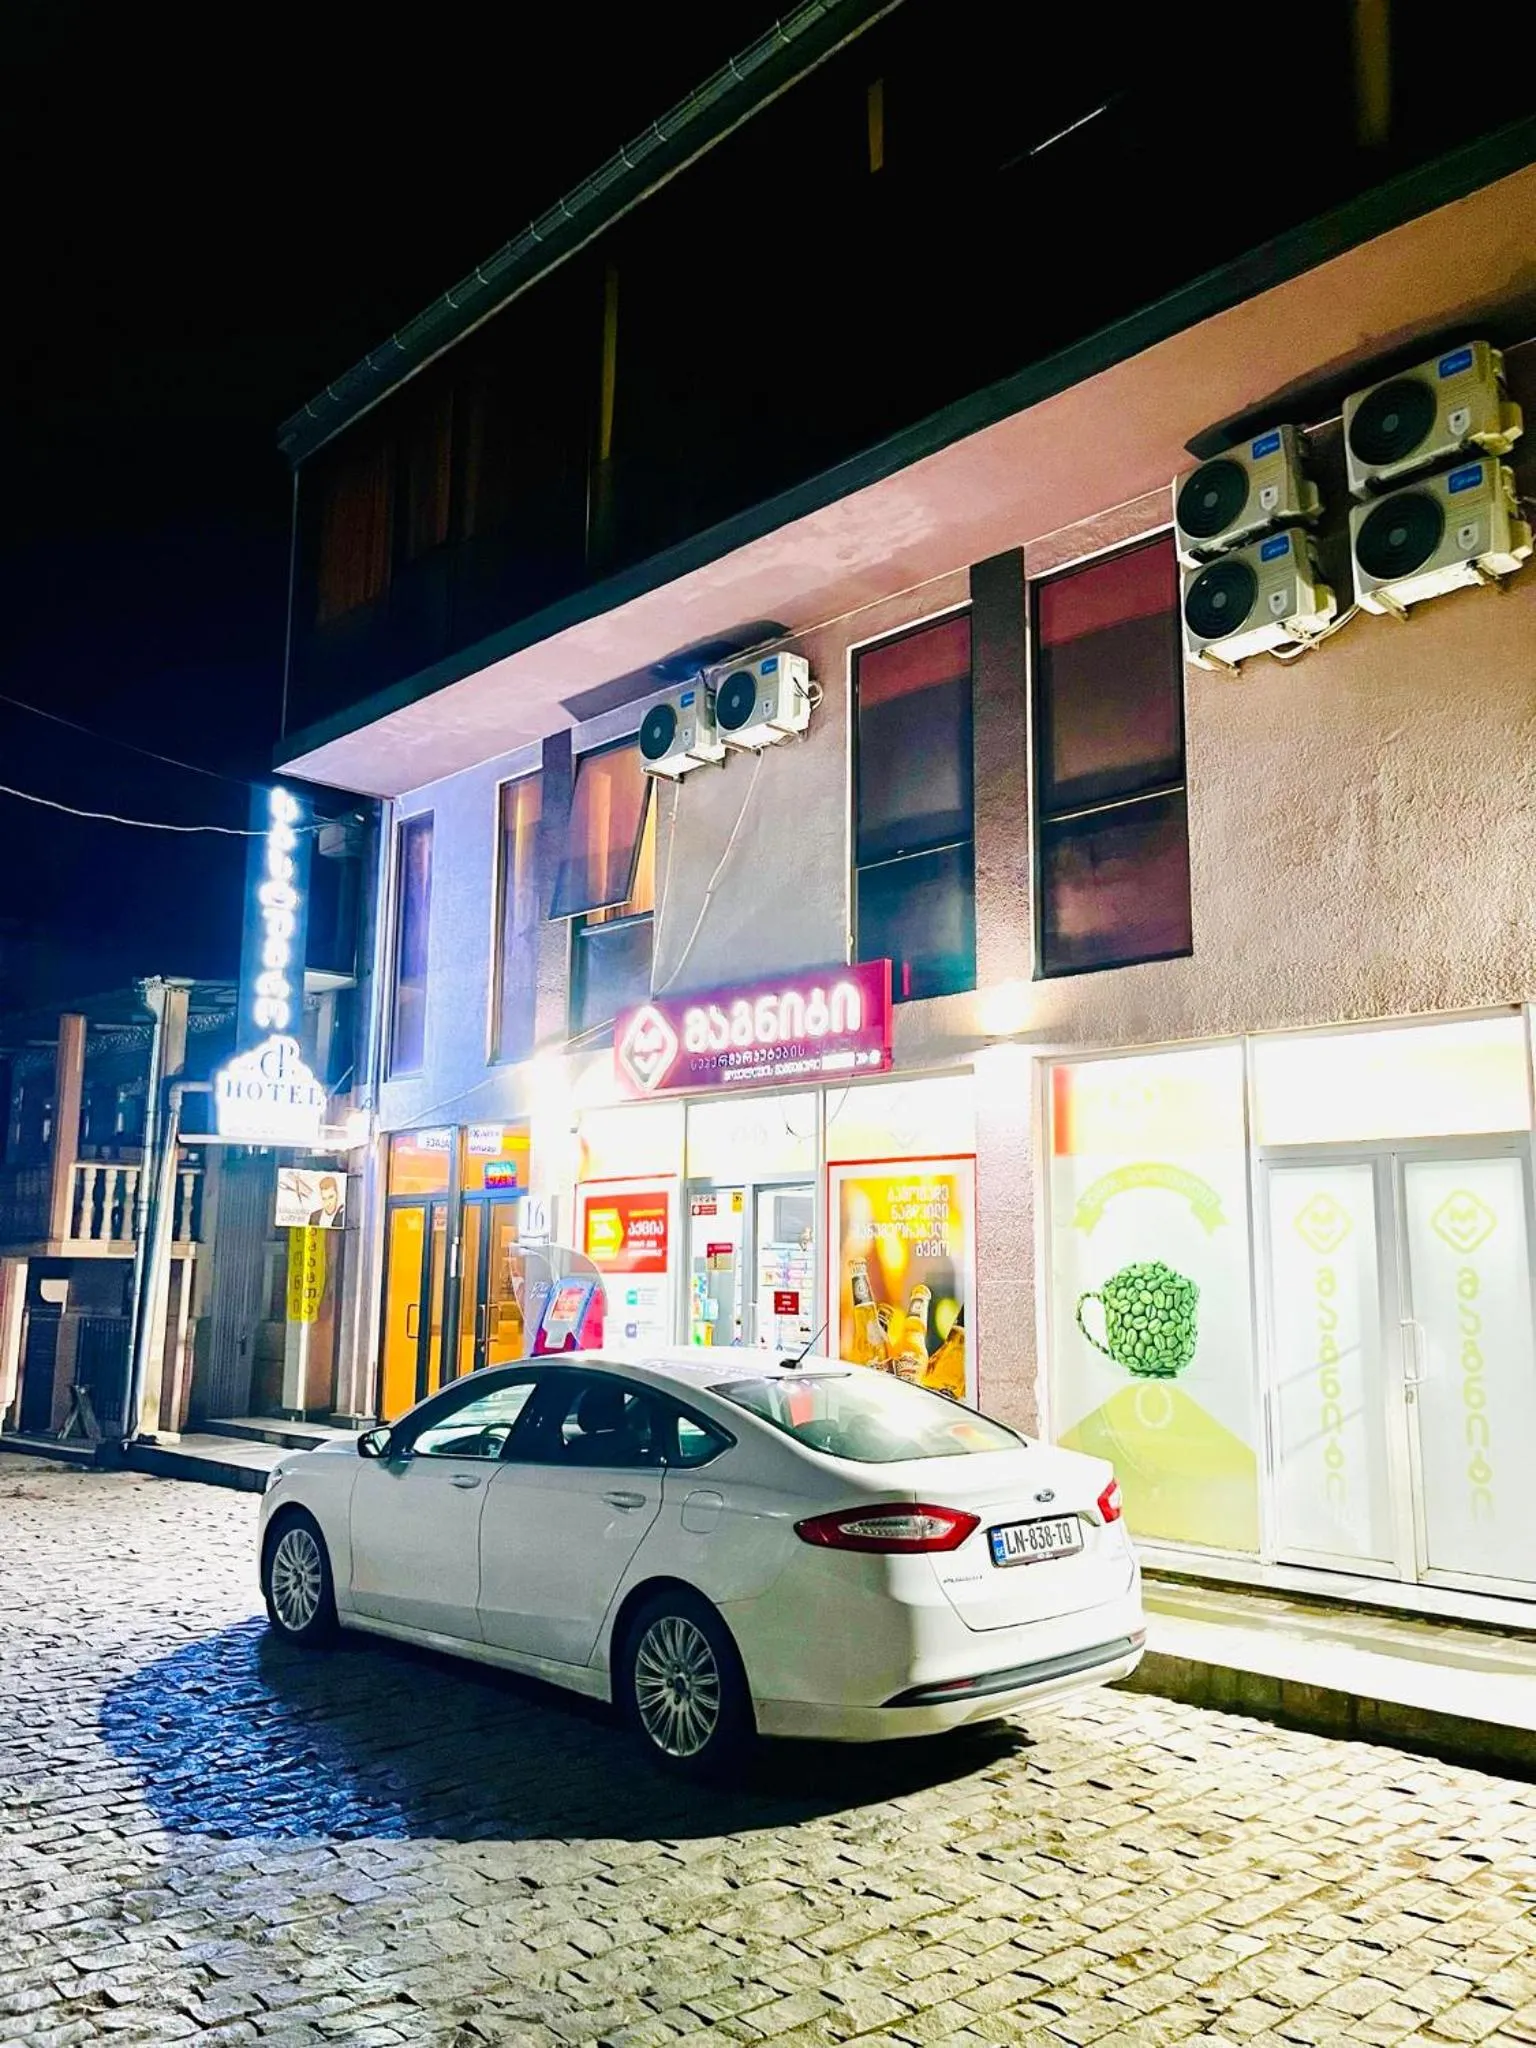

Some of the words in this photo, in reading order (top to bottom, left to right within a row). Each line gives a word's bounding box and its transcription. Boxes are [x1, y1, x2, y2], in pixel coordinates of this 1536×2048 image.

[684, 982, 861, 1053] მაგნიტი
[226, 1079, 322, 1106] HOTEL
[527, 1200, 545, 1232] 16
[1456, 1266, 1496, 1522] მაგნიტი
